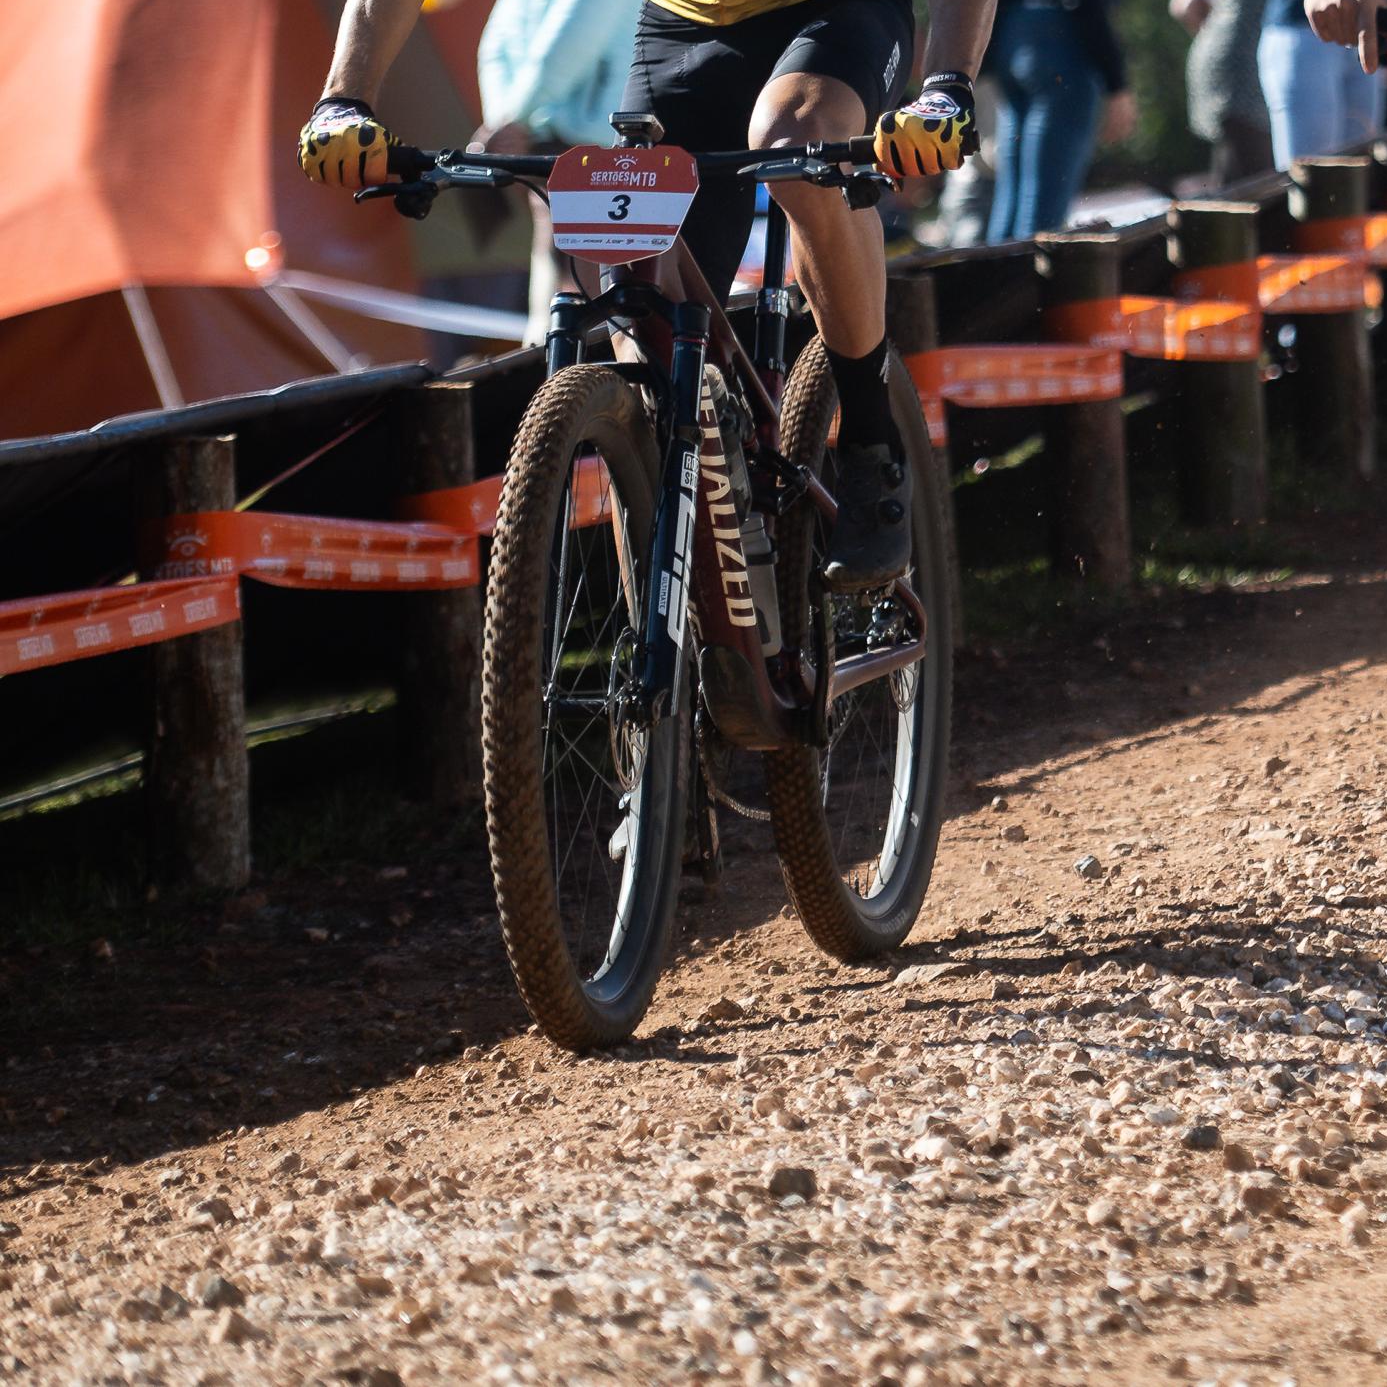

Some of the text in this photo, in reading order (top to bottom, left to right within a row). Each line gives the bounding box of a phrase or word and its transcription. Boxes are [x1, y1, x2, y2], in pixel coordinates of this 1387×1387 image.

[591, 170, 657, 187] SERTÕES MTB
[607, 194, 632, 221] 3
